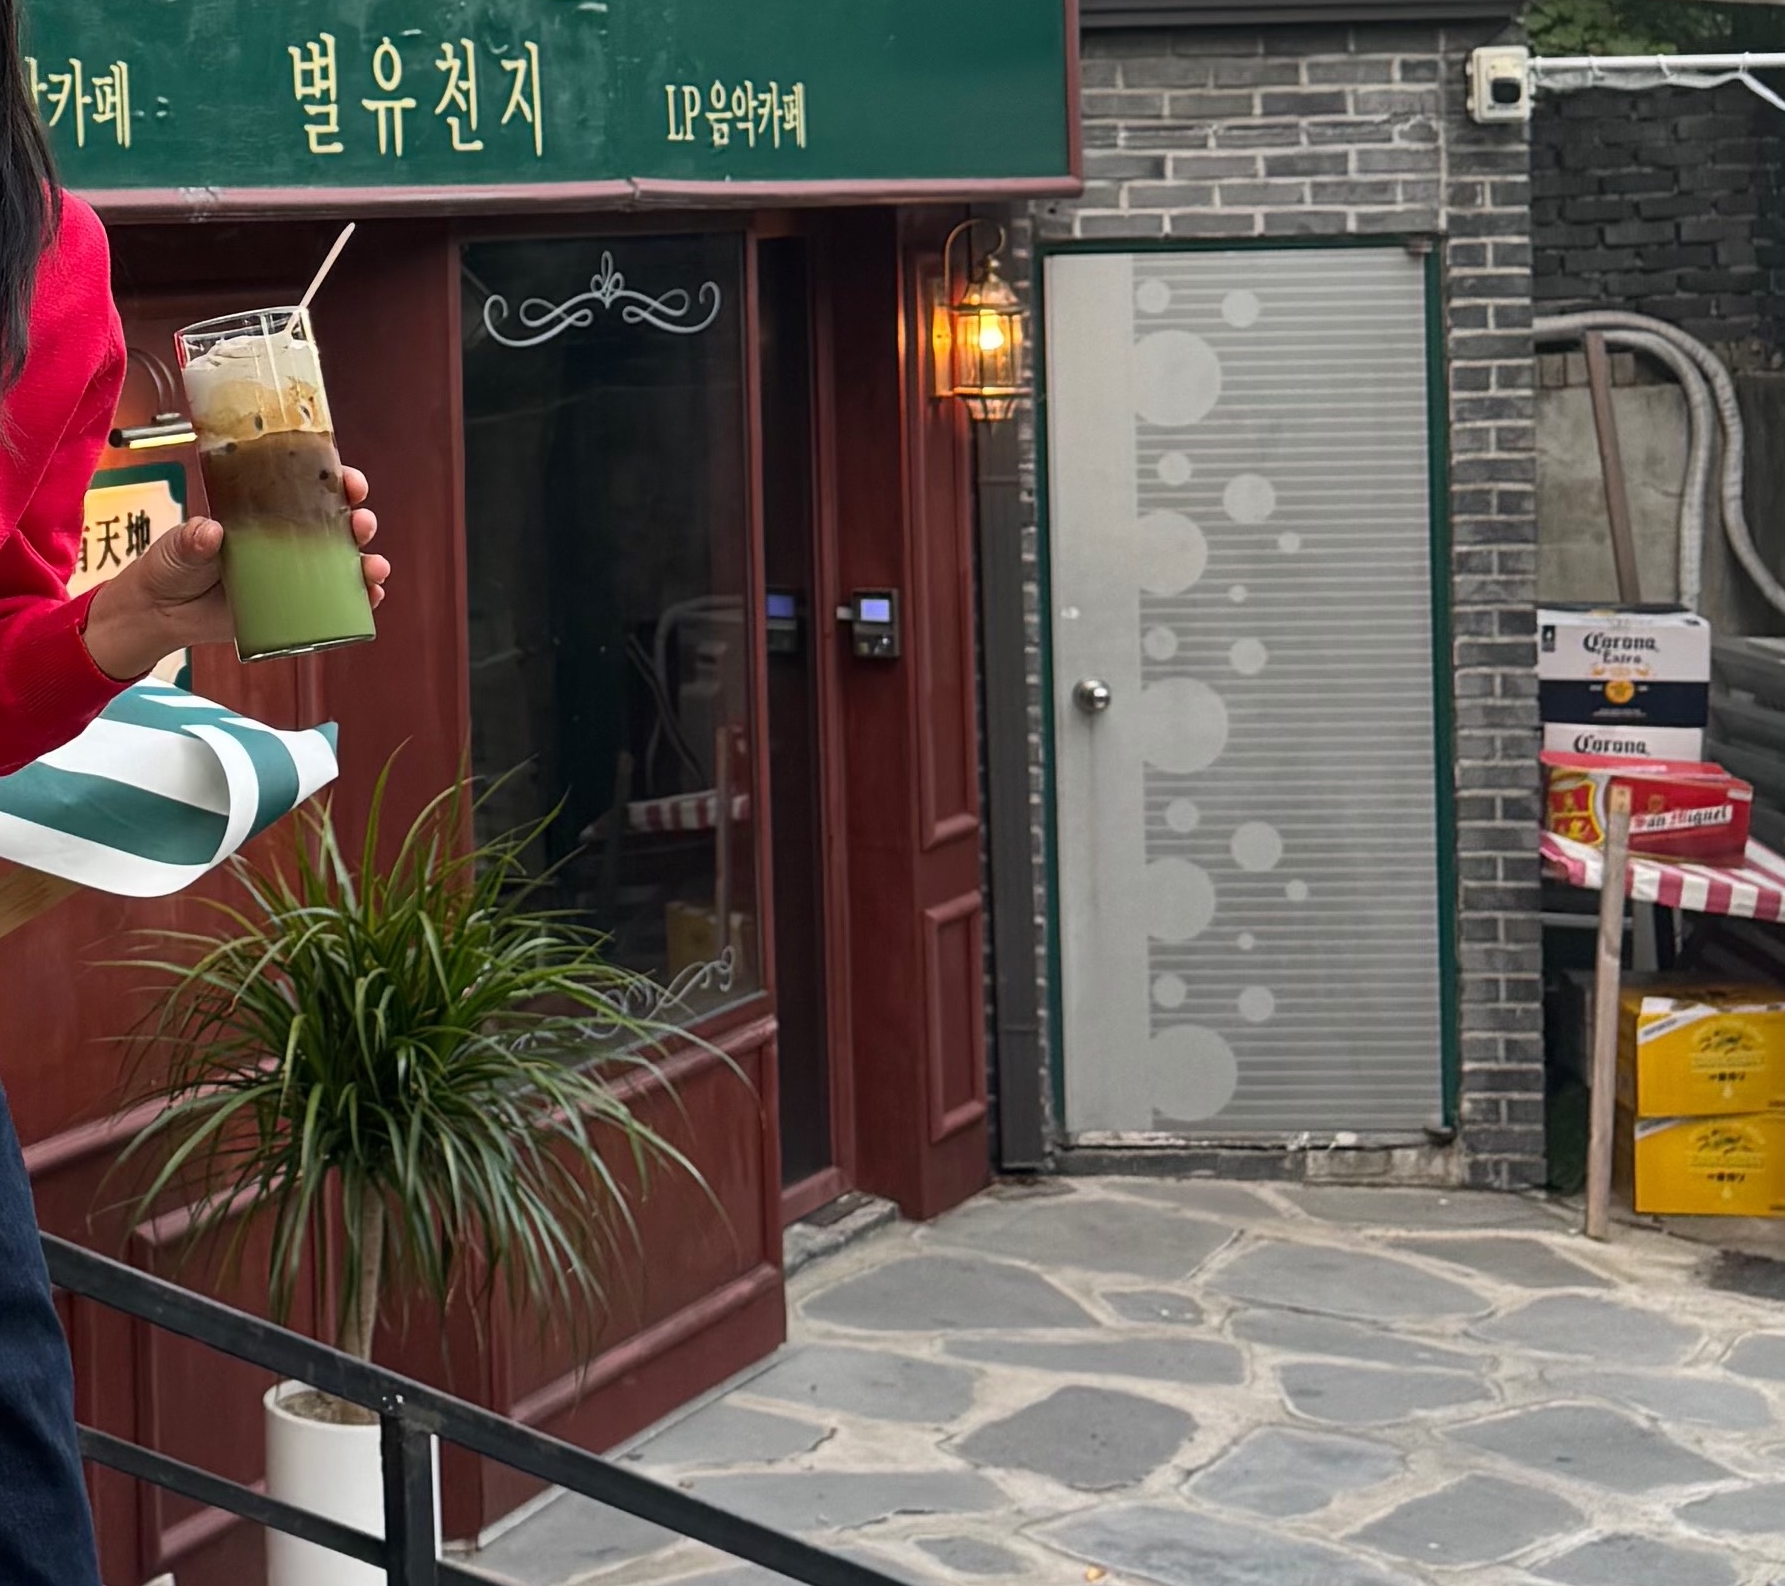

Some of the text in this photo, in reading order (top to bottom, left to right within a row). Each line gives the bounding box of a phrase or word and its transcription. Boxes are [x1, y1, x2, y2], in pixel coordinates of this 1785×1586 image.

[288, 32, 543, 157] 별유천지
[665, 79, 807, 149] LP 음악카페
[1583, 632, 1658, 653] Corona
[1573, 733, 1649, 755] Corona
